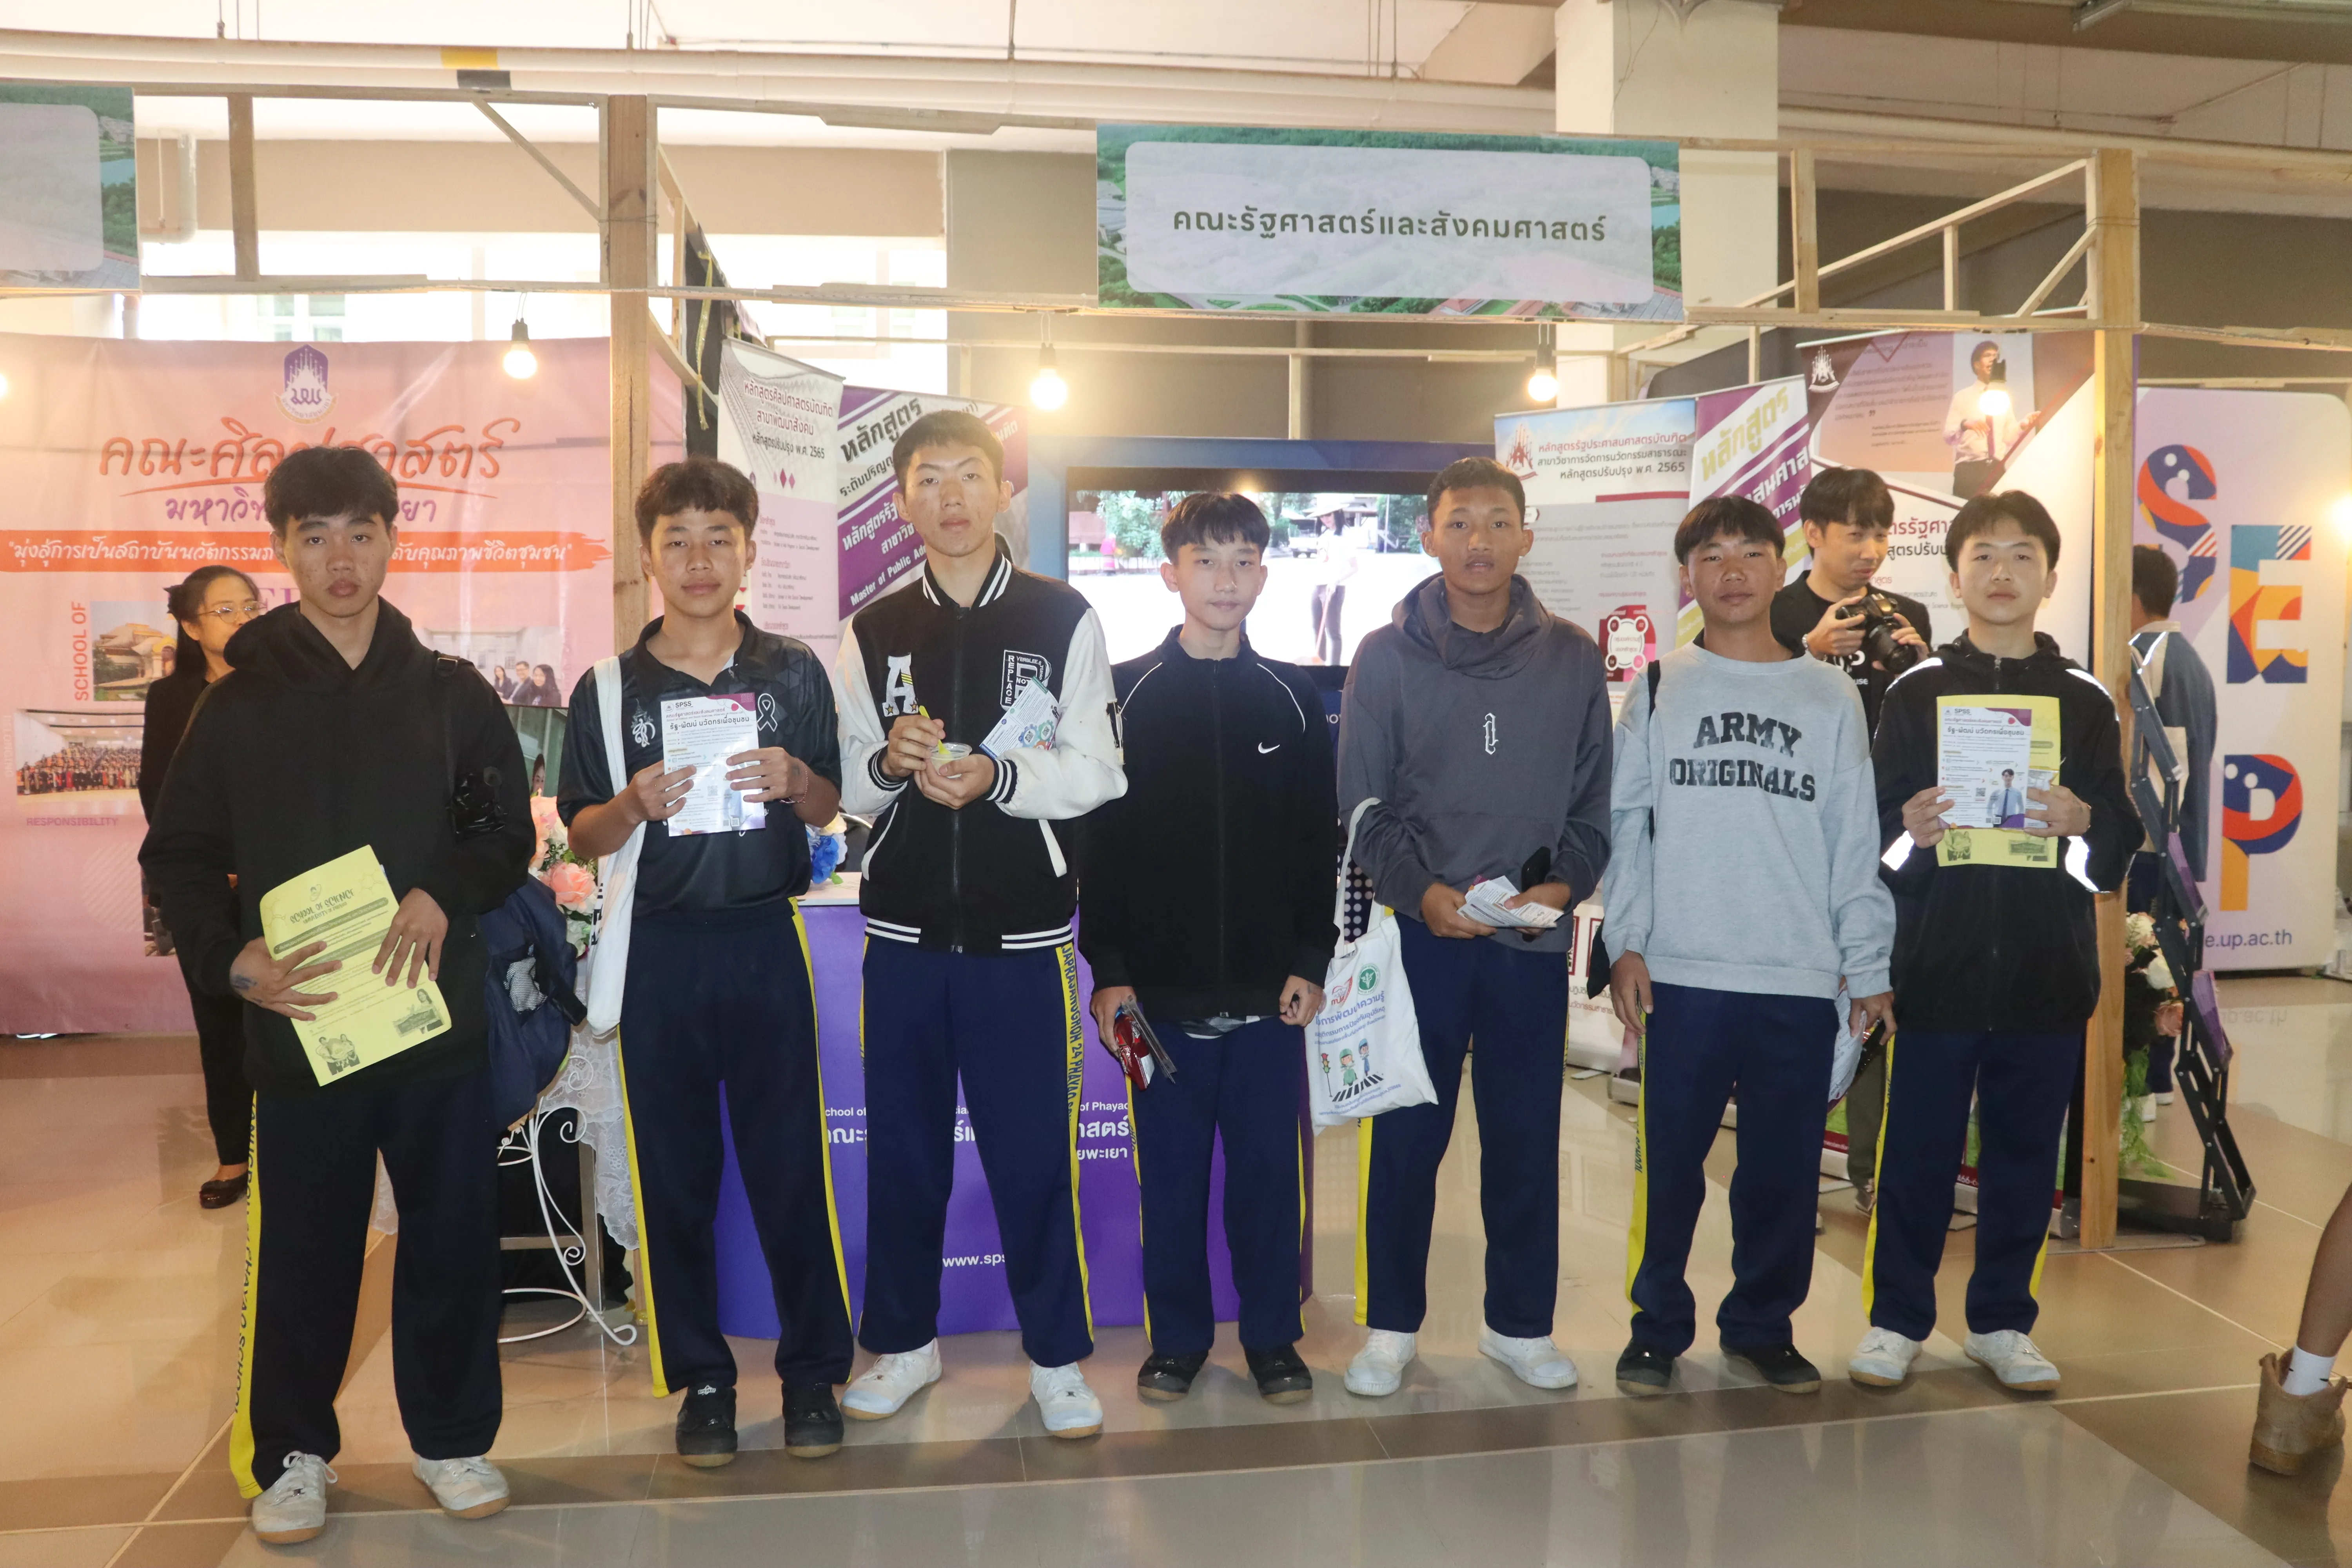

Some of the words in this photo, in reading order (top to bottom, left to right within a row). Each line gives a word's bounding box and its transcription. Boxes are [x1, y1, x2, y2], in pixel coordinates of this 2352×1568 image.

[1173, 207, 1606, 241] คณะรัฐศาสตร์และสังคมศาสตร์
[757, 410, 813, 435] สาขาพัฒนาสังคม
[840, 397, 922, 462] หลักสูตร
[1700, 386, 1789, 481] หลักสูตร
[810, 445, 825, 458] 2565
[1657, 462, 1685, 472] 2565
[850, 581, 876, 606] Master
[878, 572, 886, 585] of
[887, 555, 911, 577] Public
[71, 601, 86, 625] OF
[74, 630, 89, 701] SCHOOL
[1005, 655, 1015, 704] REPLACE
[882, 652, 919, 717] A
[1693, 711, 1802, 757] ARMY
[1670, 759, 1815, 802] ORIGINALS
[27, 817, 118, 827] RESPONSIBILITY
[290, 907, 315, 924] SCHOOL
[325, 888, 355, 907] SCIENCE
[1071, 1044, 1084, 1059] 24
[825, 1107, 854, 1116] chool
[1080, 1102, 1090, 1111] of
